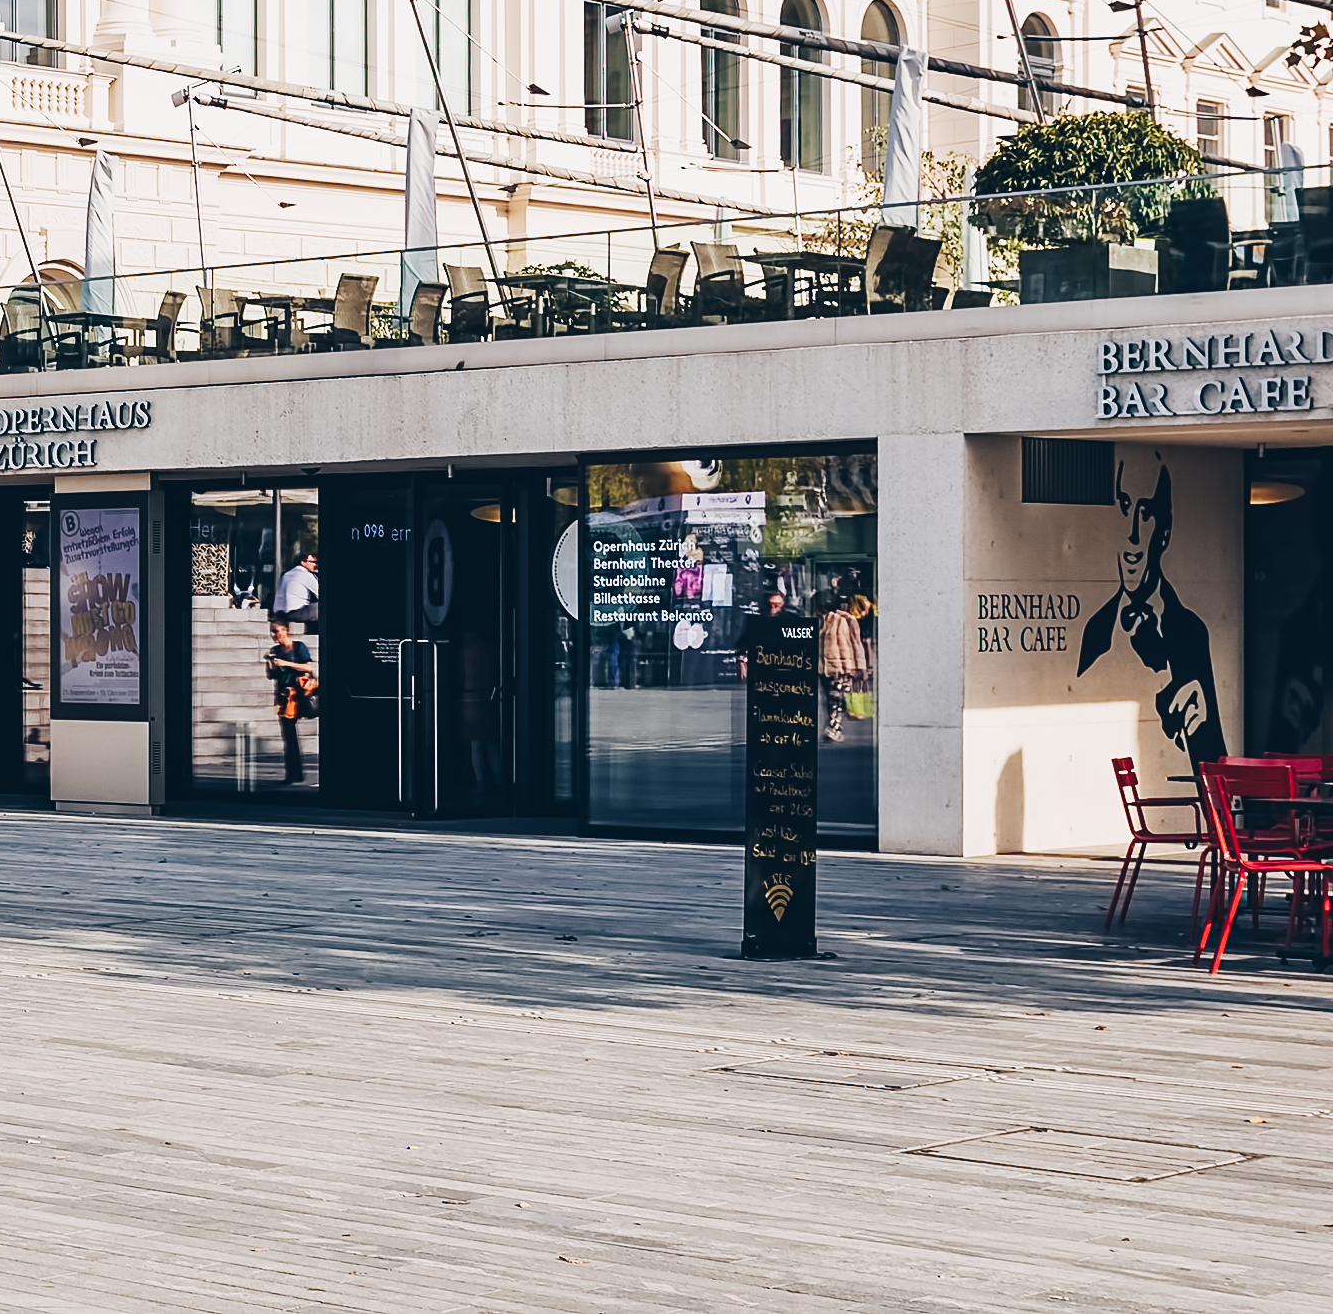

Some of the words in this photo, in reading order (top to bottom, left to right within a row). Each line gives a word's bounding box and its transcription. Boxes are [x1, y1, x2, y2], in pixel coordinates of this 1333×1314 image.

[1095, 380, 1177, 420] BAR
[1191, 375, 1315, 416] CAFE
[363, 523, 385, 538] 098
[593, 539, 656, 556] Opernhaus
[658, 538, 696, 552] Zürich
[593, 556, 646, 570] Bernhard
[650, 556, 696, 569] Theater
[593, 574, 666, 587] Studiobühne
[593, 591, 661, 605] Billettkasse
[977, 594, 1081, 620] BERNHARD
[593, 608, 659, 622] Restaurant
[660, 608, 714, 622] Belcanto
[781, 627, 813, 639] VALSER
[977, 626, 1013, 653] BAR
[1020, 626, 1068, 652] CAFE
[755, 646, 813, 671] Bernhard's
